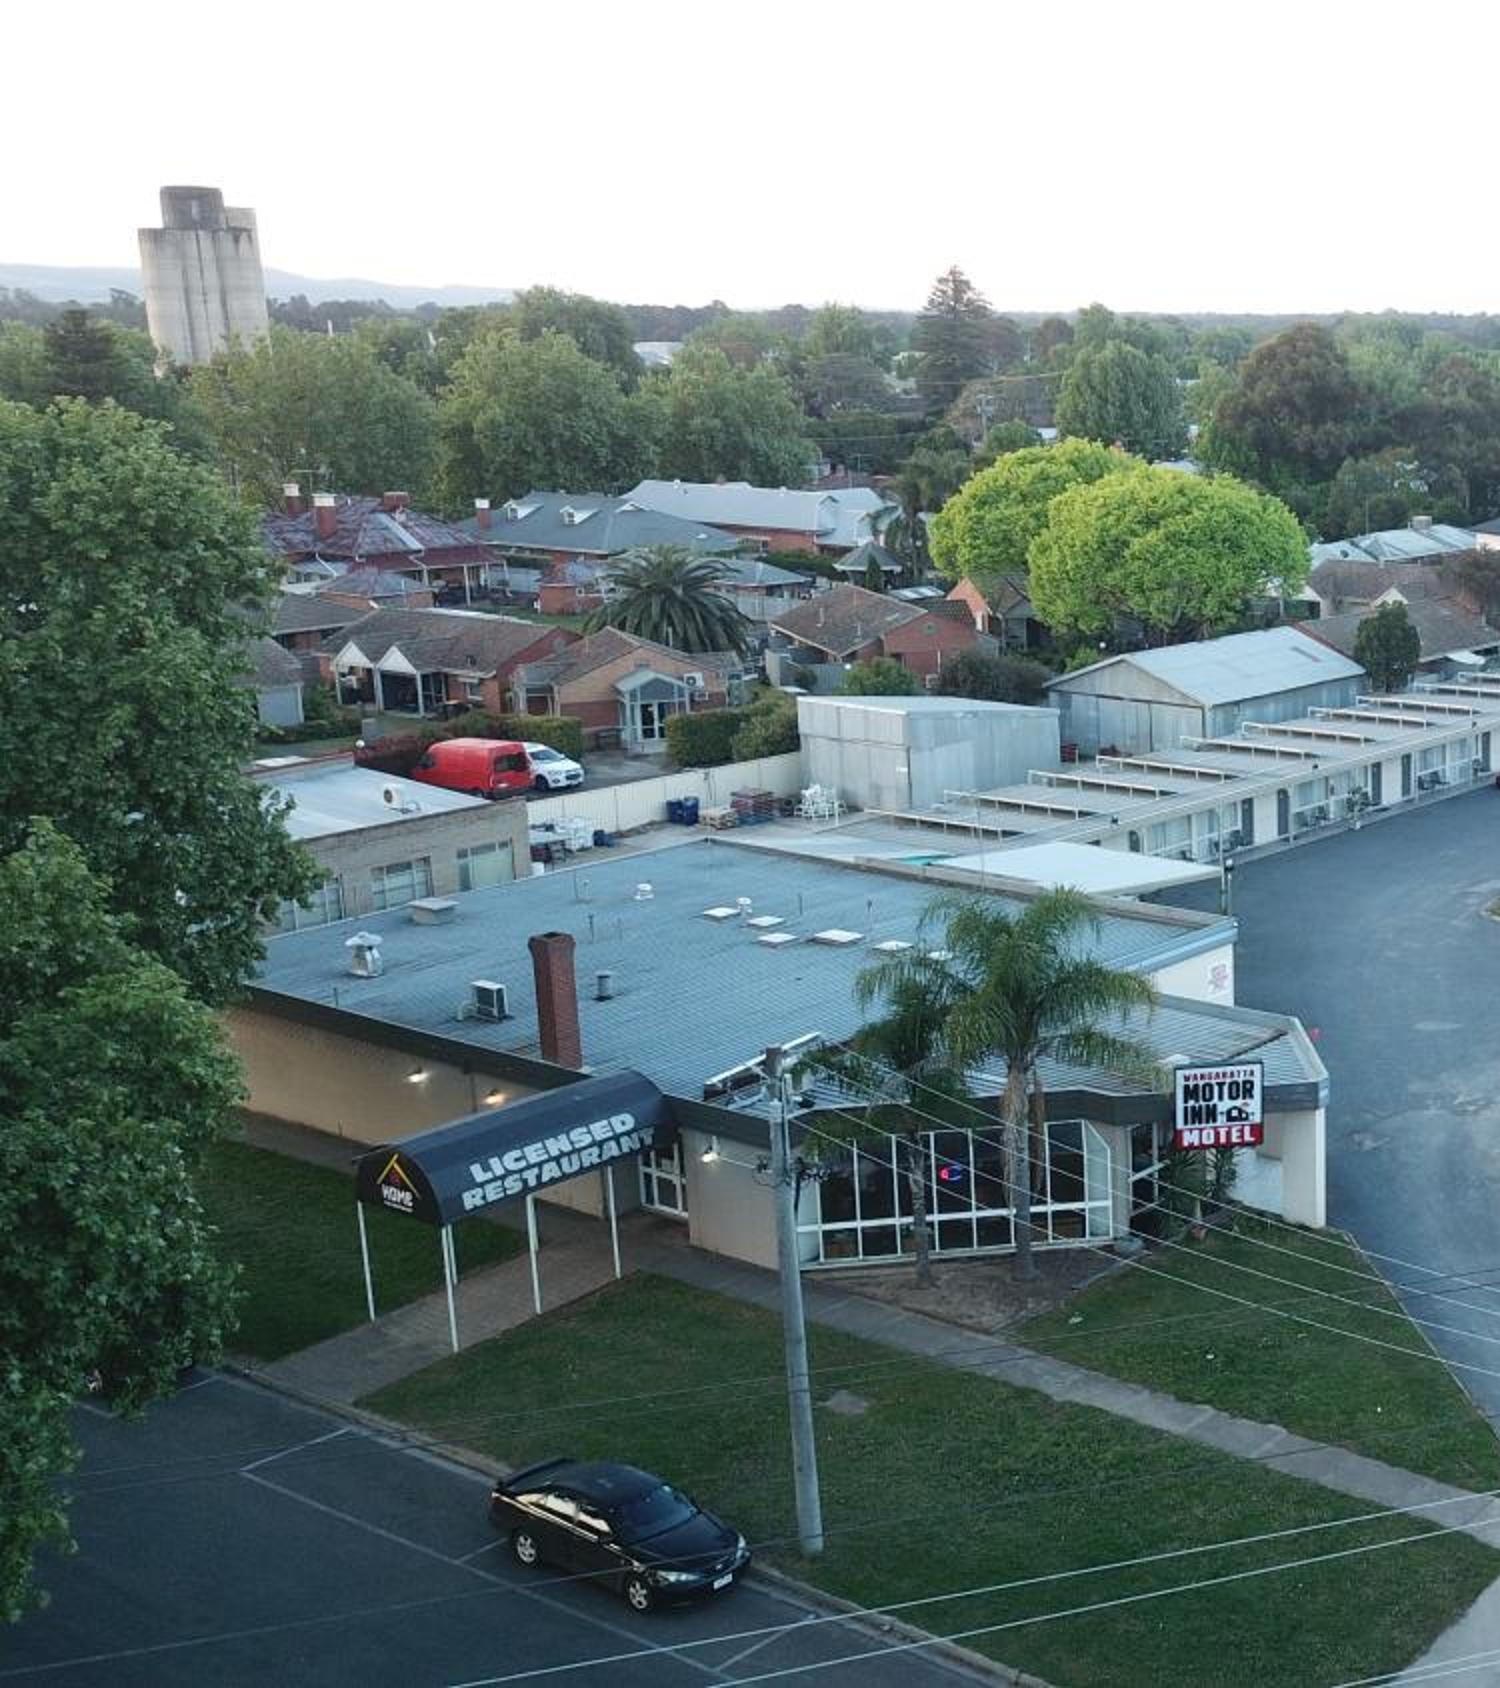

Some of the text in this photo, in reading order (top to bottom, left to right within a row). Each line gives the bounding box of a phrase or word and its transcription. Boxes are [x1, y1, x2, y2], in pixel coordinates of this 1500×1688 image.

[1183, 1069, 1255, 1082] WANGARATTA
[1183, 1080, 1255, 1104] MOTOR
[1183, 1103, 1218, 1126] INN
[468, 1112, 636, 1184] LICENSED
[1182, 1125, 1256, 1148] MOTEL
[461, 1126, 655, 1212] RESTAURANT
